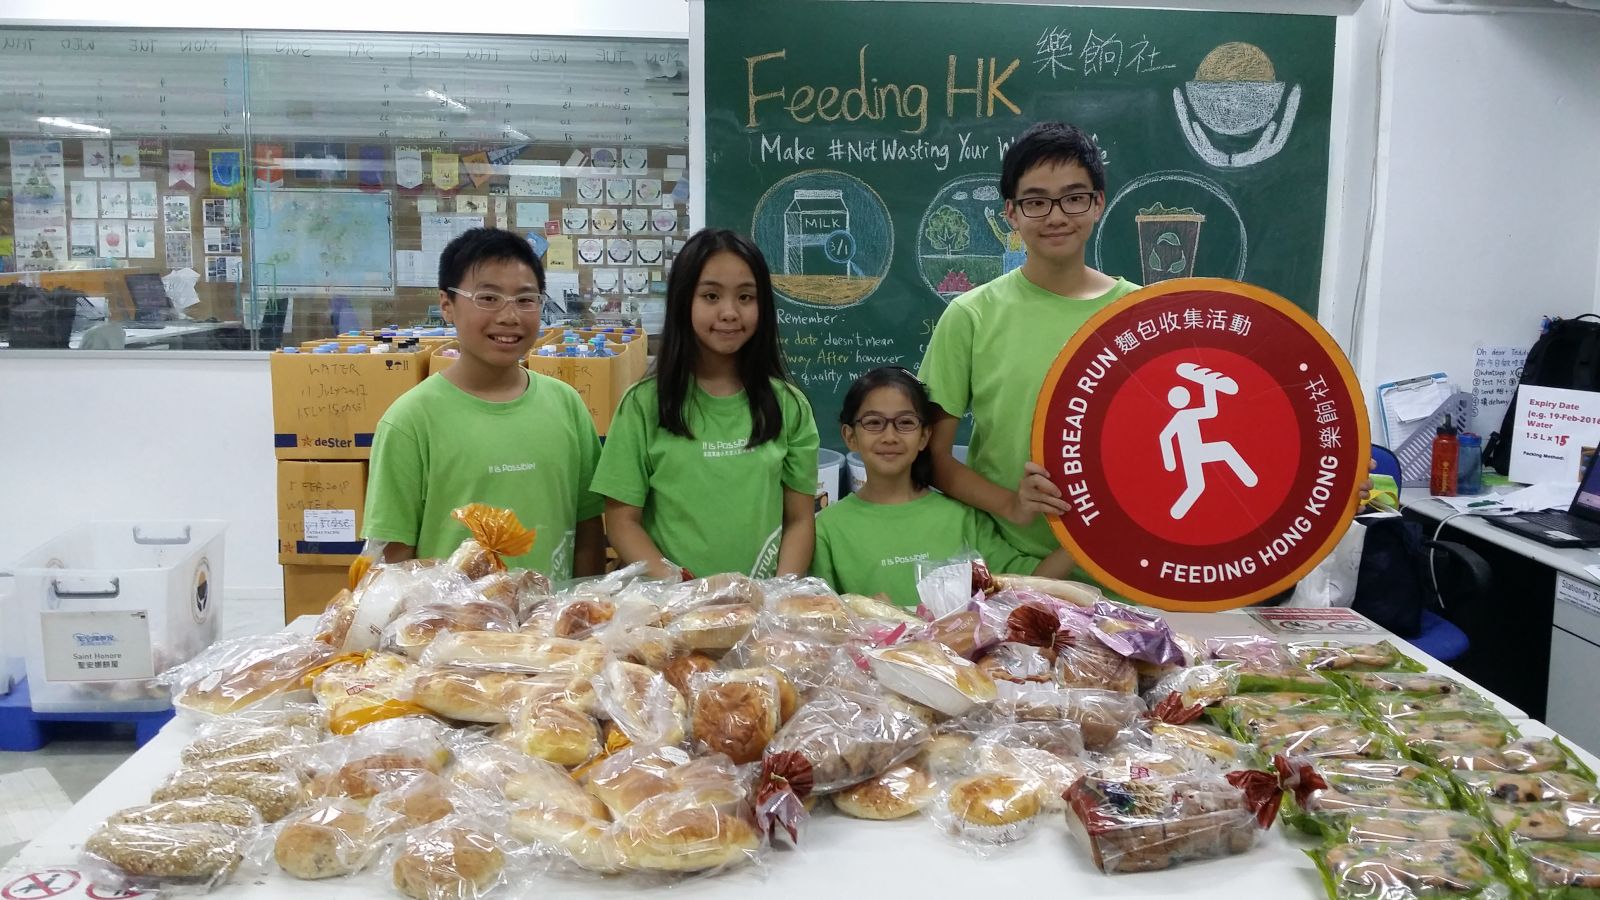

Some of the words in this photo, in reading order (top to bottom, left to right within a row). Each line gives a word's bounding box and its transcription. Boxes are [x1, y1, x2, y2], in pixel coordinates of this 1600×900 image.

[1033, 24, 1176, 79] 樂餉社
[745, 43, 928, 133] Feeding
[947, 54, 1021, 117] HK
[760, 133, 816, 164] Make
[957, 132, 989, 163] Your
[805, 217, 841, 229] MILK
[830, 238, 849, 257] 3/1
[865, 335, 895, 347] mean
[1113, 307, 1253, 355] 麵包收集活動
[855, 349, 905, 364] however
[308, 363, 362, 377] WATER
[1077, 346, 1119, 395] RUN
[801, 368, 843, 394] quality
[1303, 373, 1343, 449] 樂餉社
[1529, 398, 1557, 410] Expiry
[1558, 402, 1580, 410] Date
[1526, 420, 1553, 430] Water
[1528, 410, 1546, 420] (e.g.
[314, 438, 352, 448] deSter
[1062, 394, 1089, 476] BREAD
[1555, 436, 1570, 446] 15
[1523, 450, 1543, 458] Packing
[1304, 455, 1339, 517] KONG
[1068, 479, 1101, 527] THE
[1258, 515, 1313, 567] HONG
[1159, 555, 1257, 585] FEEDING
[1562, 579, 1592, 600] Stationery
[94, 652, 122, 660] Honore
